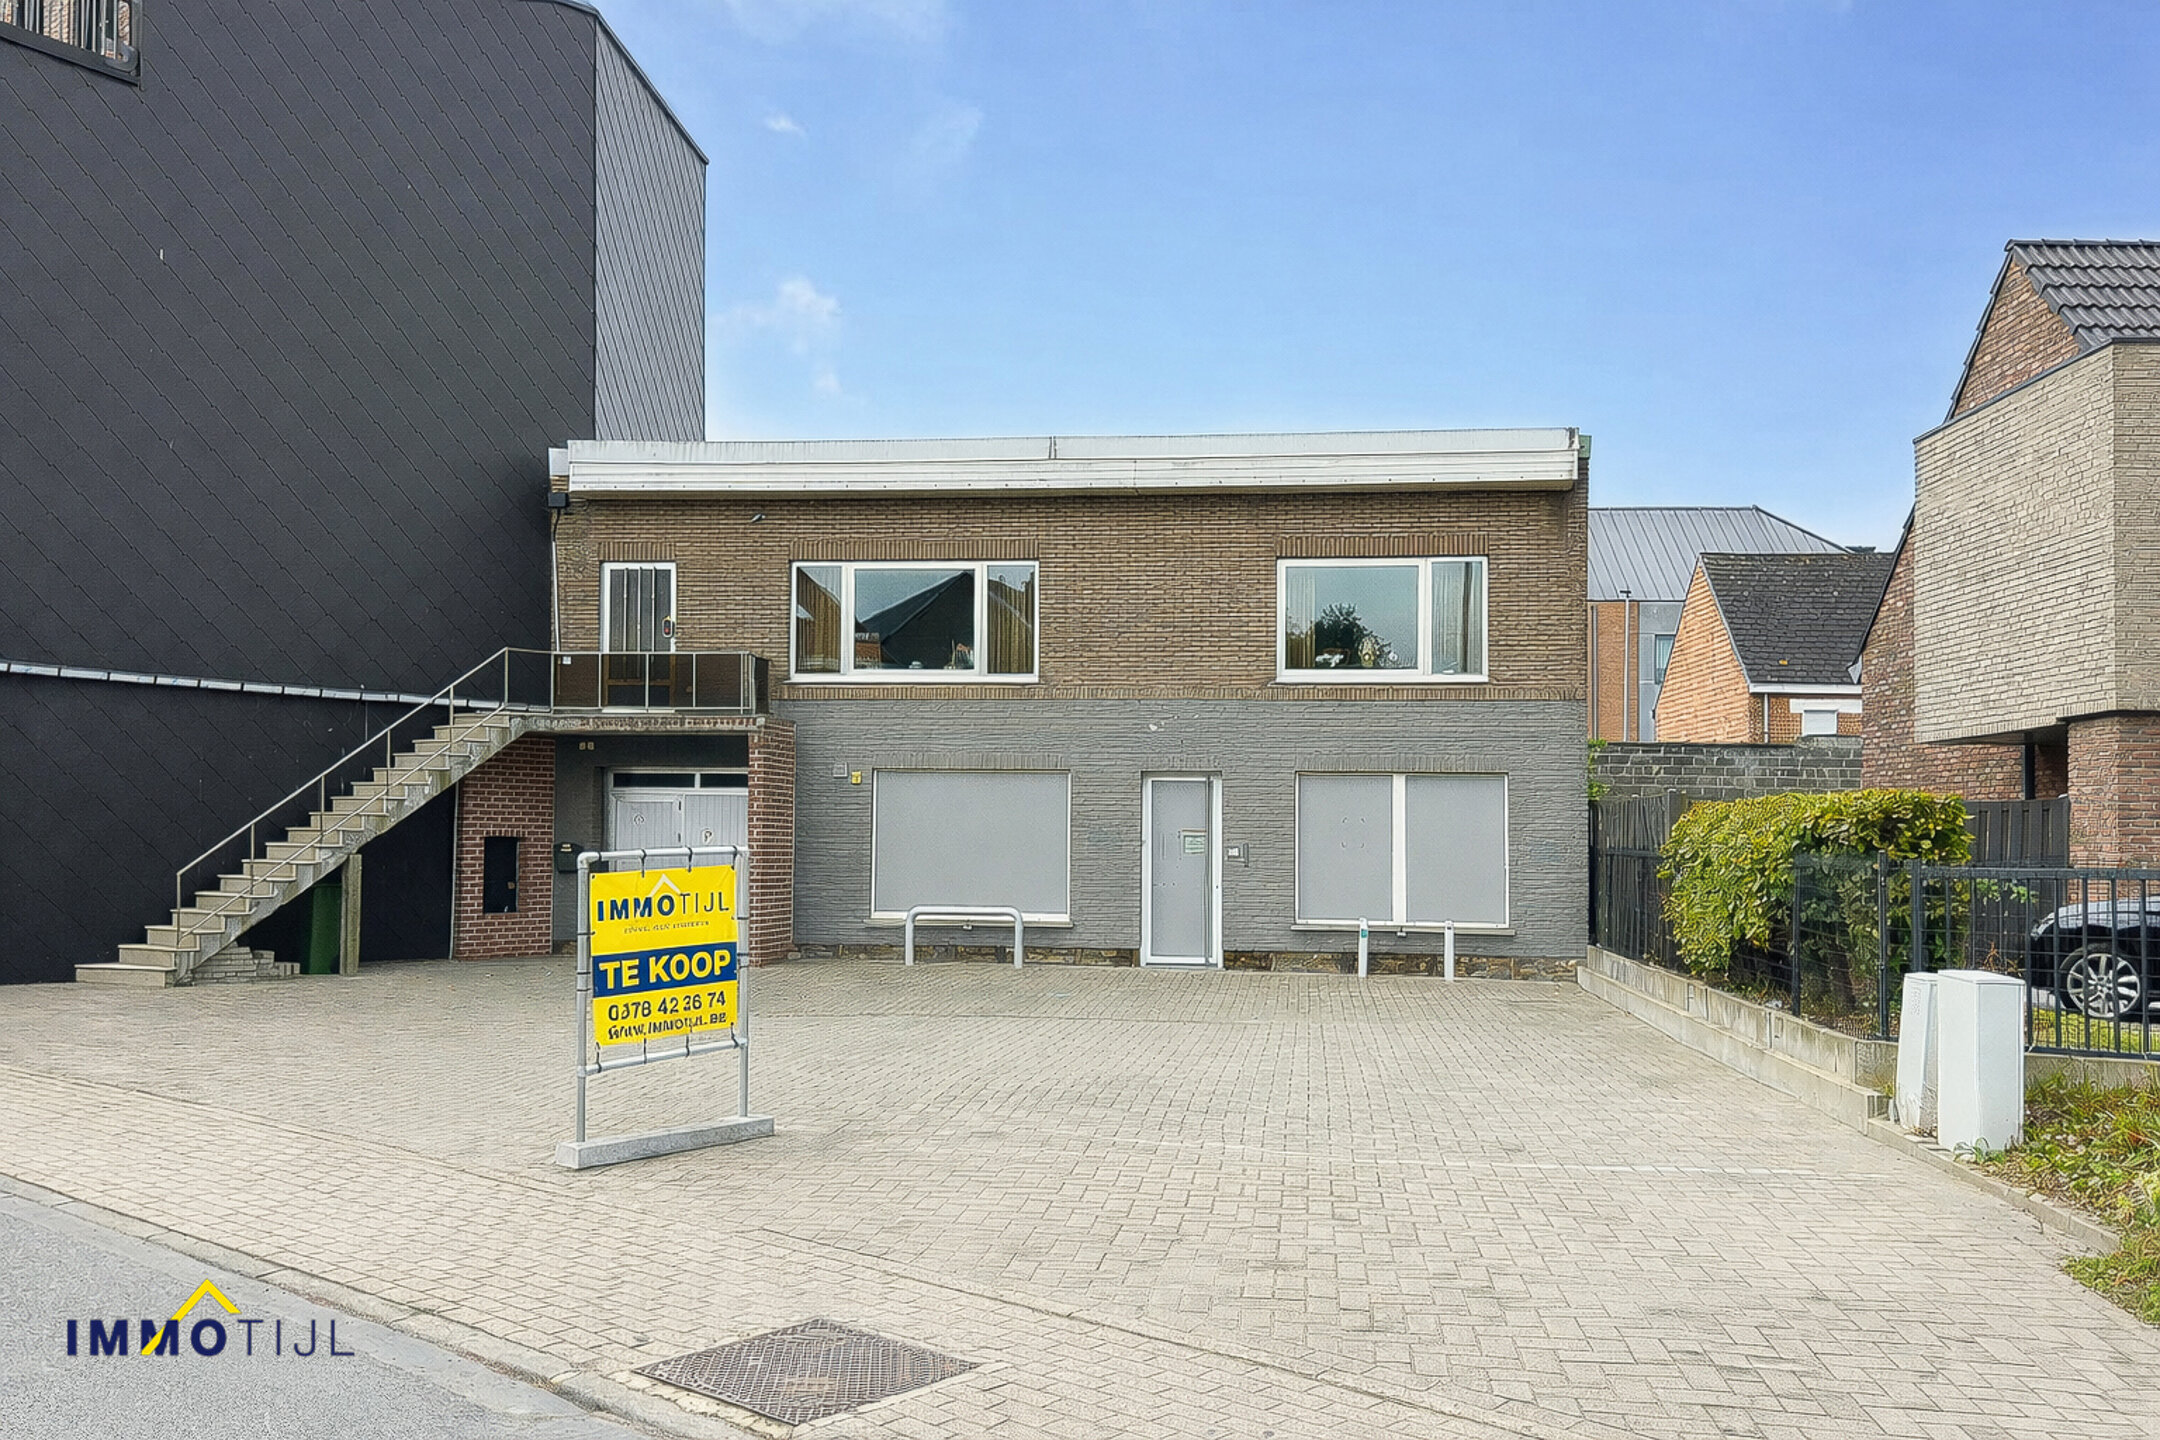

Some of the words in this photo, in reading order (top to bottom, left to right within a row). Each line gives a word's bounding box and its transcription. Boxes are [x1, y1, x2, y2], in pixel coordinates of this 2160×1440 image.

[597, 891, 730, 922] IMMOTIJL
[599, 958, 640, 990] TE
[648, 949, 732, 984] KOOP
[657, 997, 679, 1014] 42
[707, 990, 726, 1008] 74
